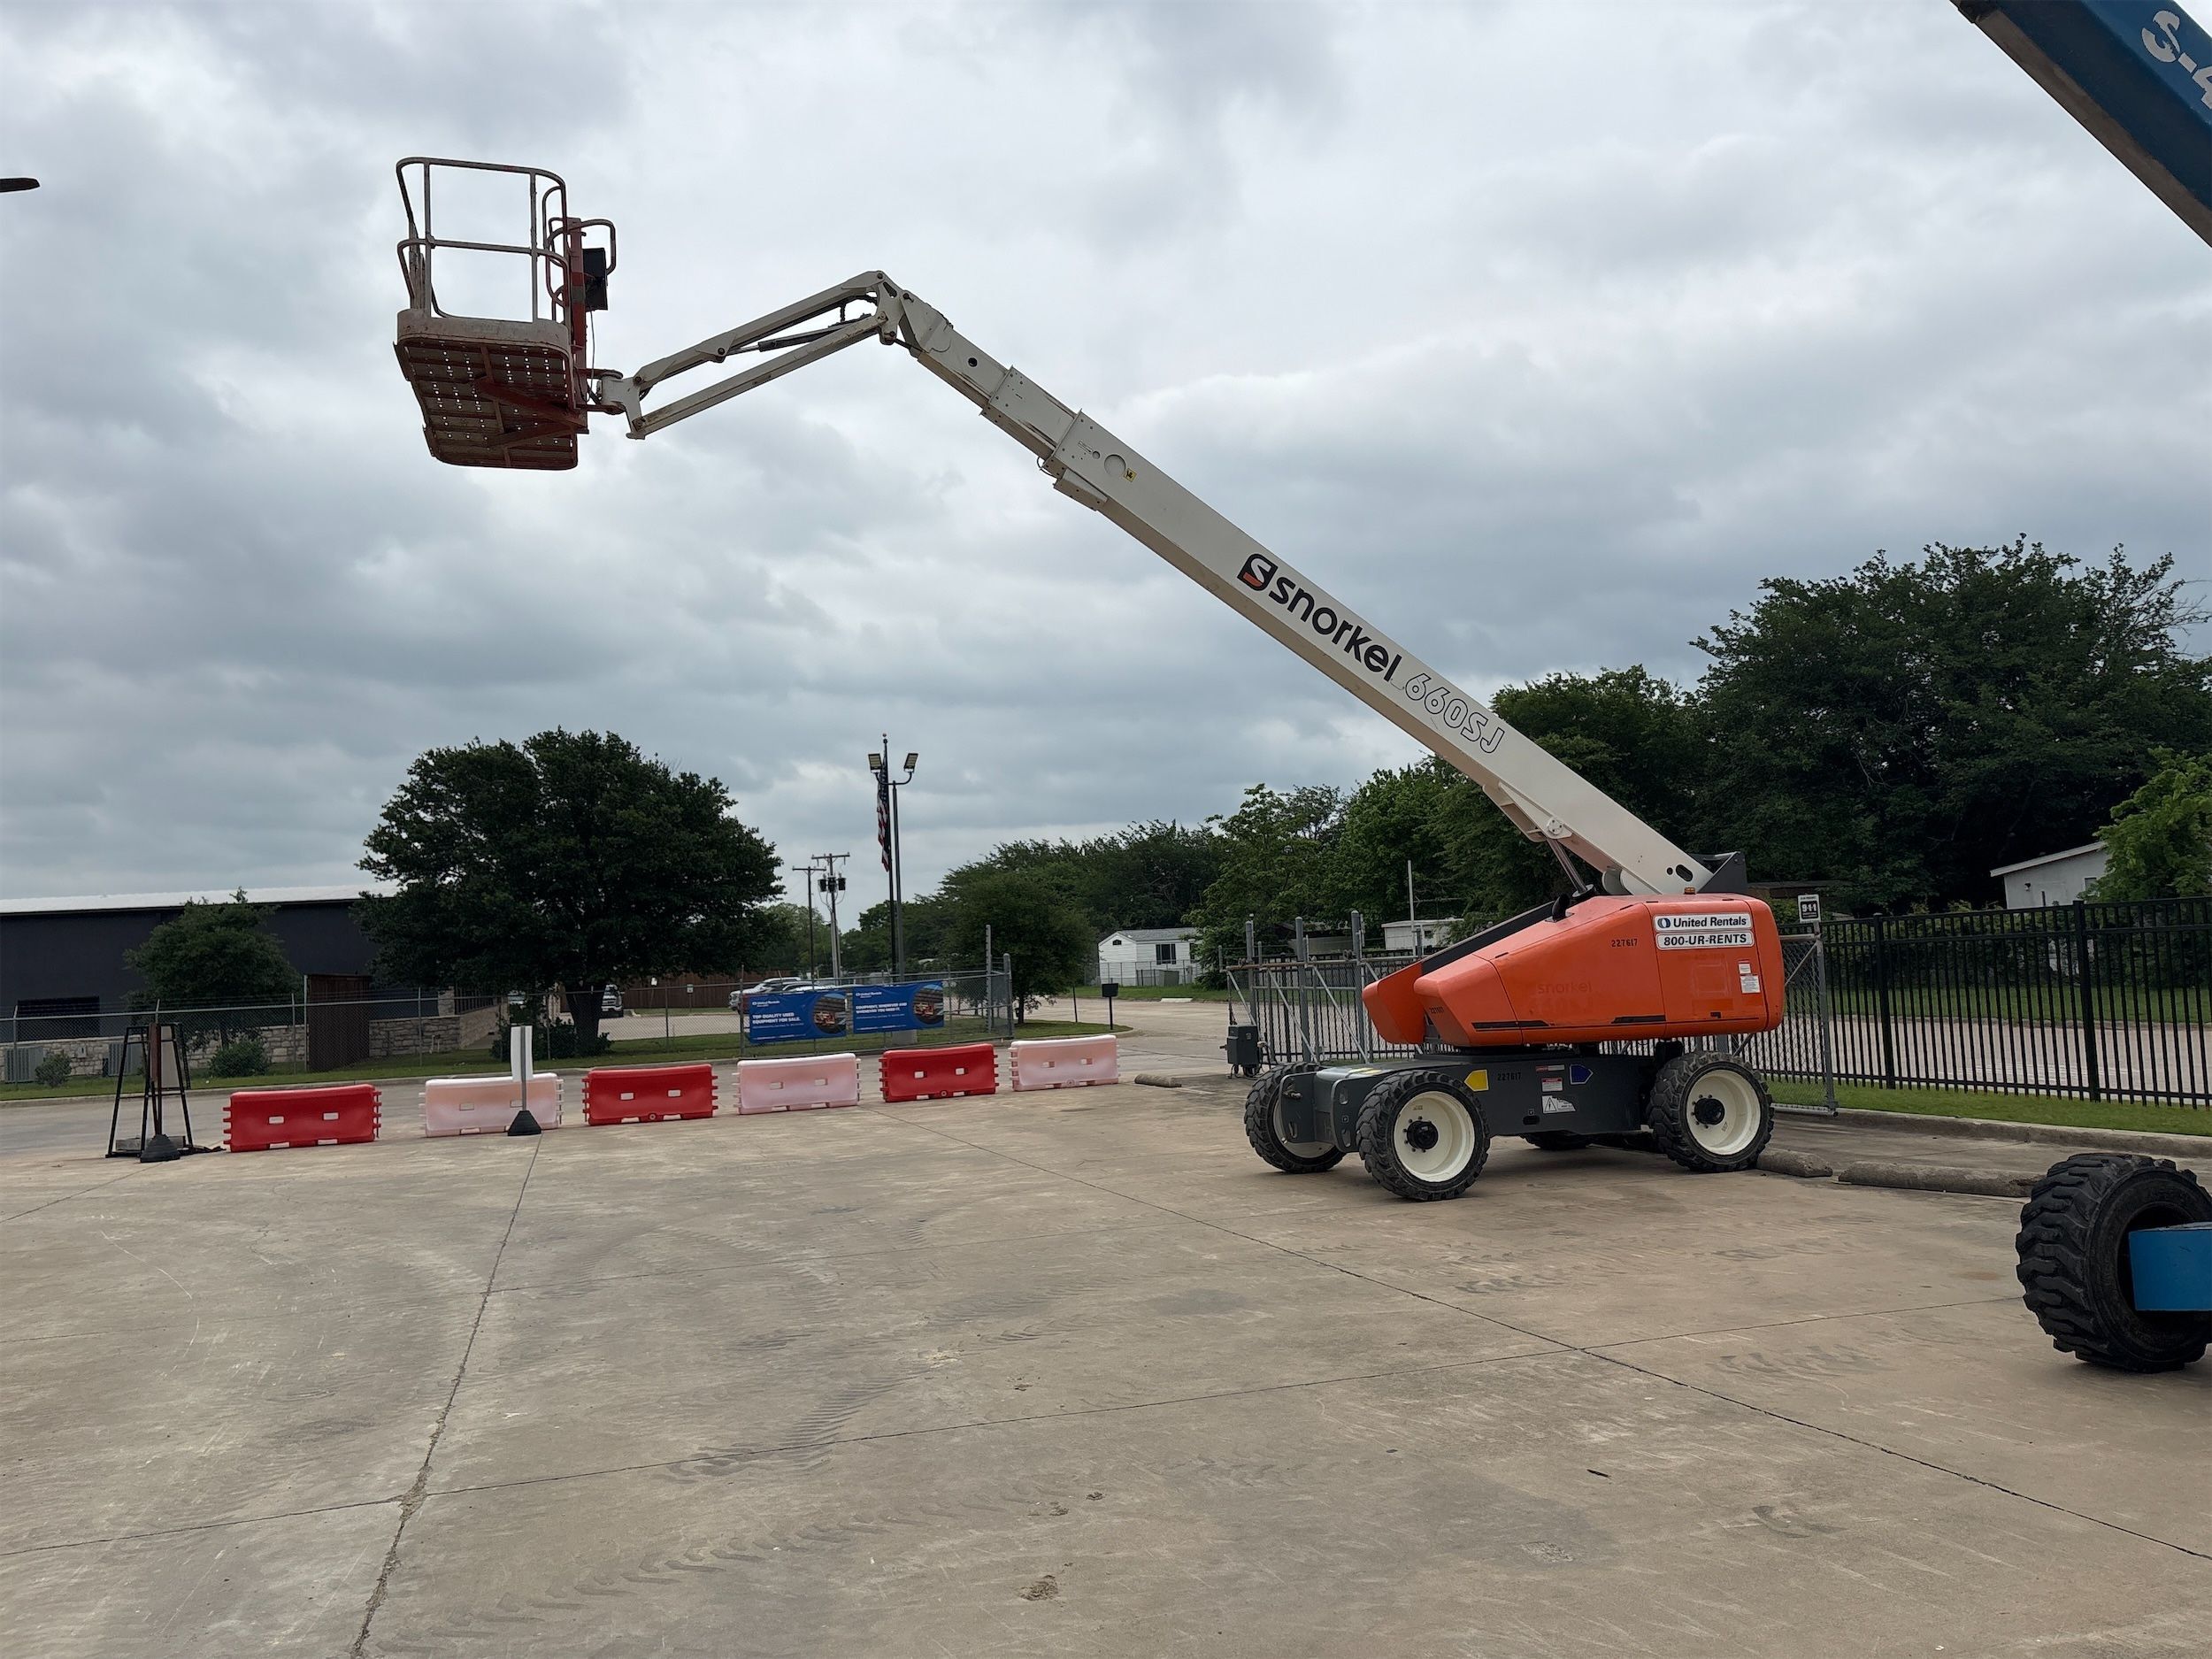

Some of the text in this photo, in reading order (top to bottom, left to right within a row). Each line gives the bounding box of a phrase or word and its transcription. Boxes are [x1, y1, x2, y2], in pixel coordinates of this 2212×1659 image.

[1268, 576, 1402, 682] snorkel
[1405, 672, 1505, 753] 660SJ
[1673, 916, 1747, 927] United Rentals
[1611, 938, 1638, 948] 227617
[1663, 933, 1747, 946] 800-UR-RENTS
